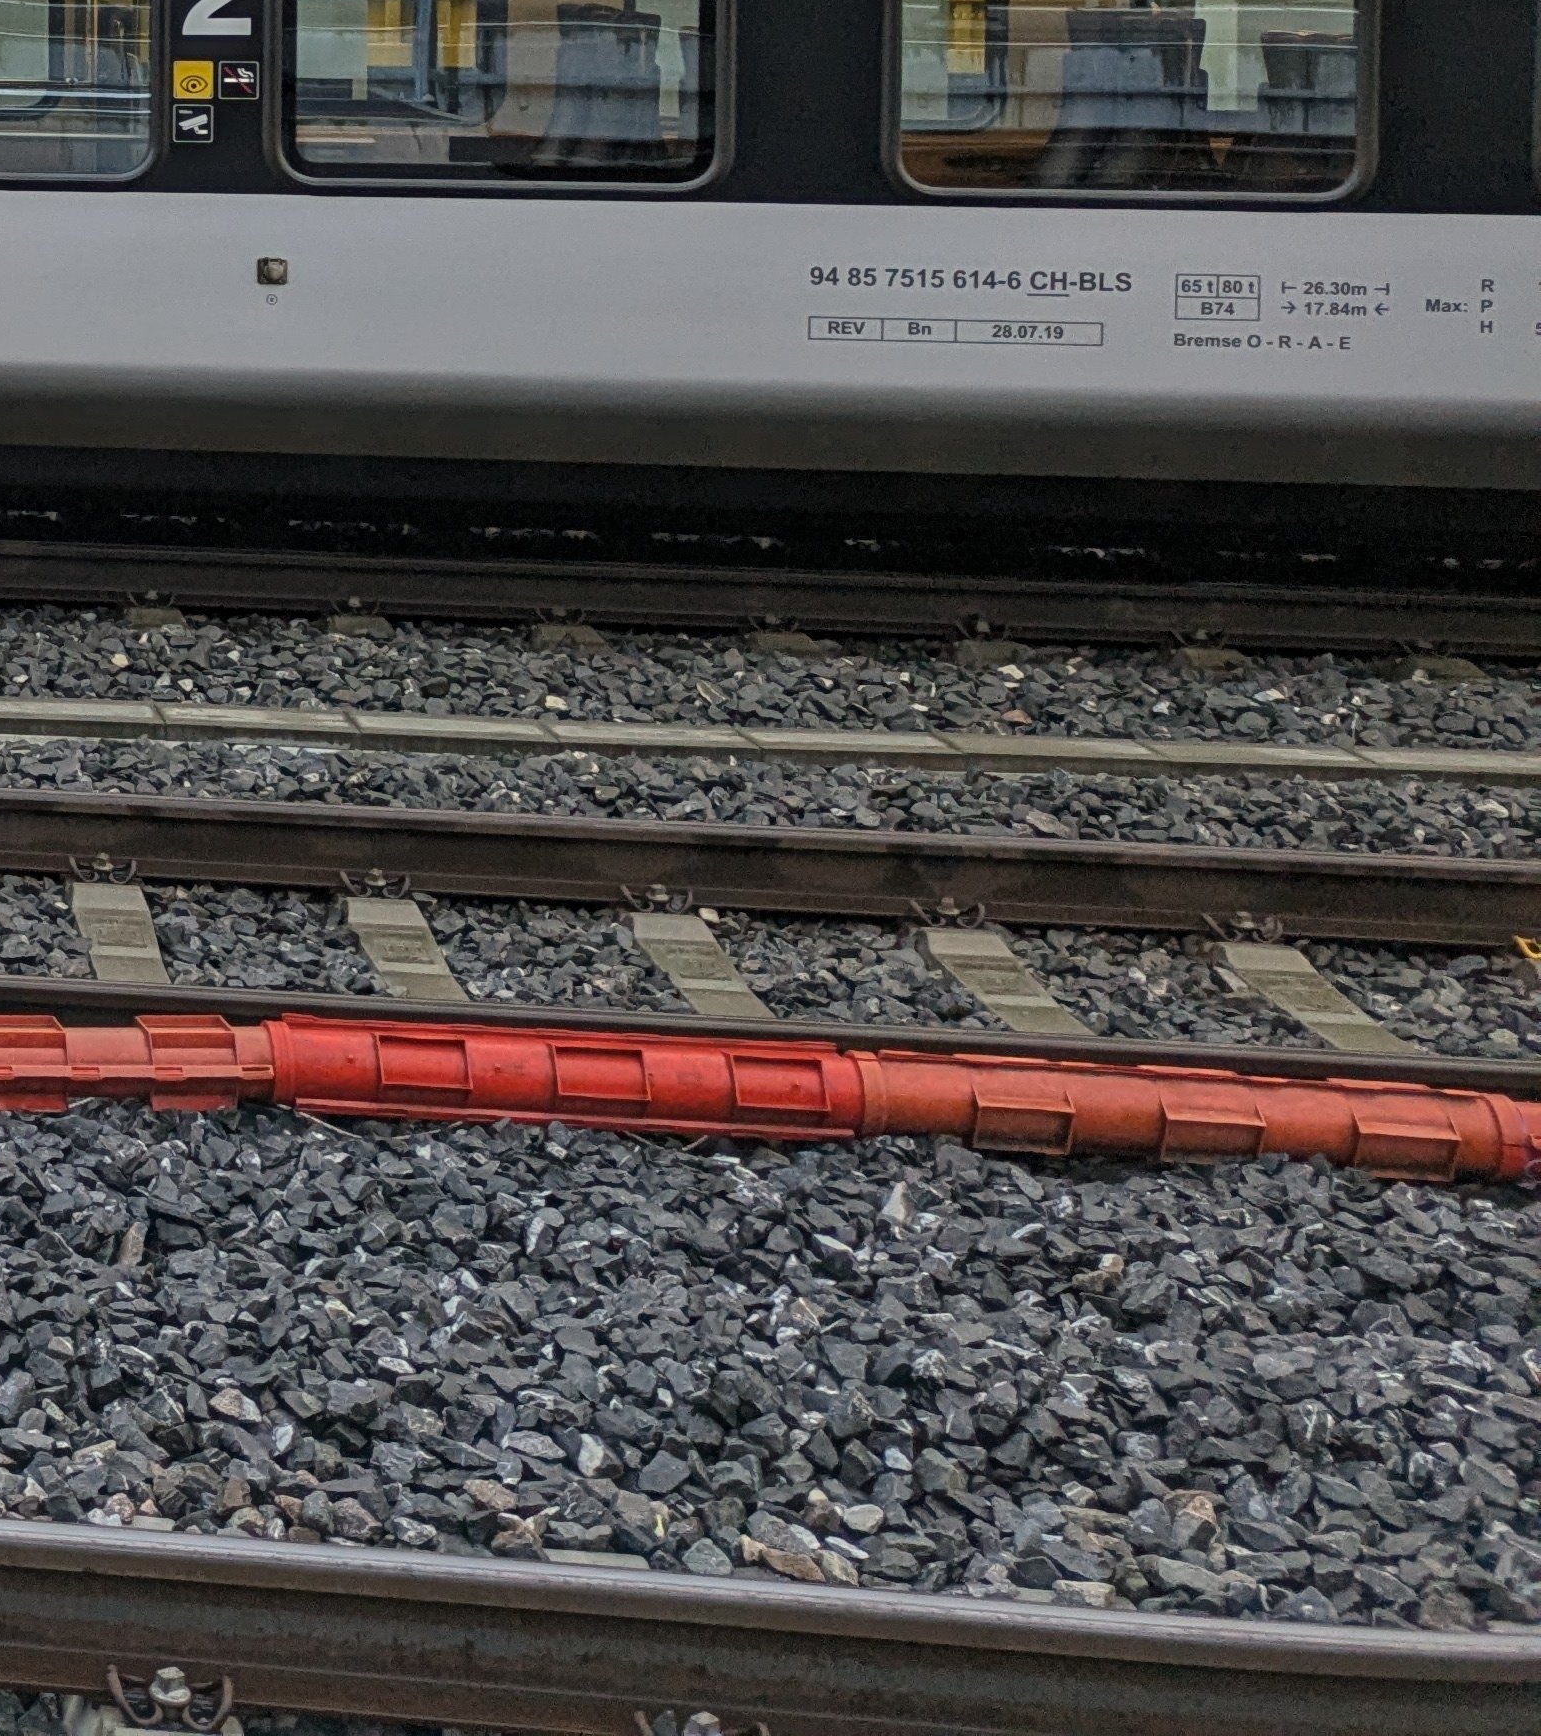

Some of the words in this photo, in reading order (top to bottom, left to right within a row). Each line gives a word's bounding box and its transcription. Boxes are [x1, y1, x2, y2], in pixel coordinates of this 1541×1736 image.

[809, 266, 840, 286] 94
[847, 267, 878, 287] 85
[884, 268, 945, 288] 7515
[952, 270, 1022, 290] 614-6
[1028, 271, 1133, 292] CH-BLS
[1481, 279, 1495, 293] R
[1180, 279, 1202, 294] 65
[1207, 281, 1214, 294] t
[1222, 280, 1244, 294] 80
[1248, 281, 1255, 294] t
[1302, 282, 1367, 296] 26.30m
[1201, 302, 1235, 316] B74
[1304, 302, 1367, 316] 17.84m
[1425, 298, 1469, 313] Max:
[1480, 300, 1493, 313] P
[827, 321, 866, 335] REV
[908, 322, 932, 336] Bn
[992, 324, 1064, 340] 28.07.19
[1480, 320, 1493, 334] H
[1173, 334, 1242, 348] Bremse
[1278, 335, 1292, 349] R
[1307, 336, 1323, 350] A
[1339, 337, 1352, 350] E
